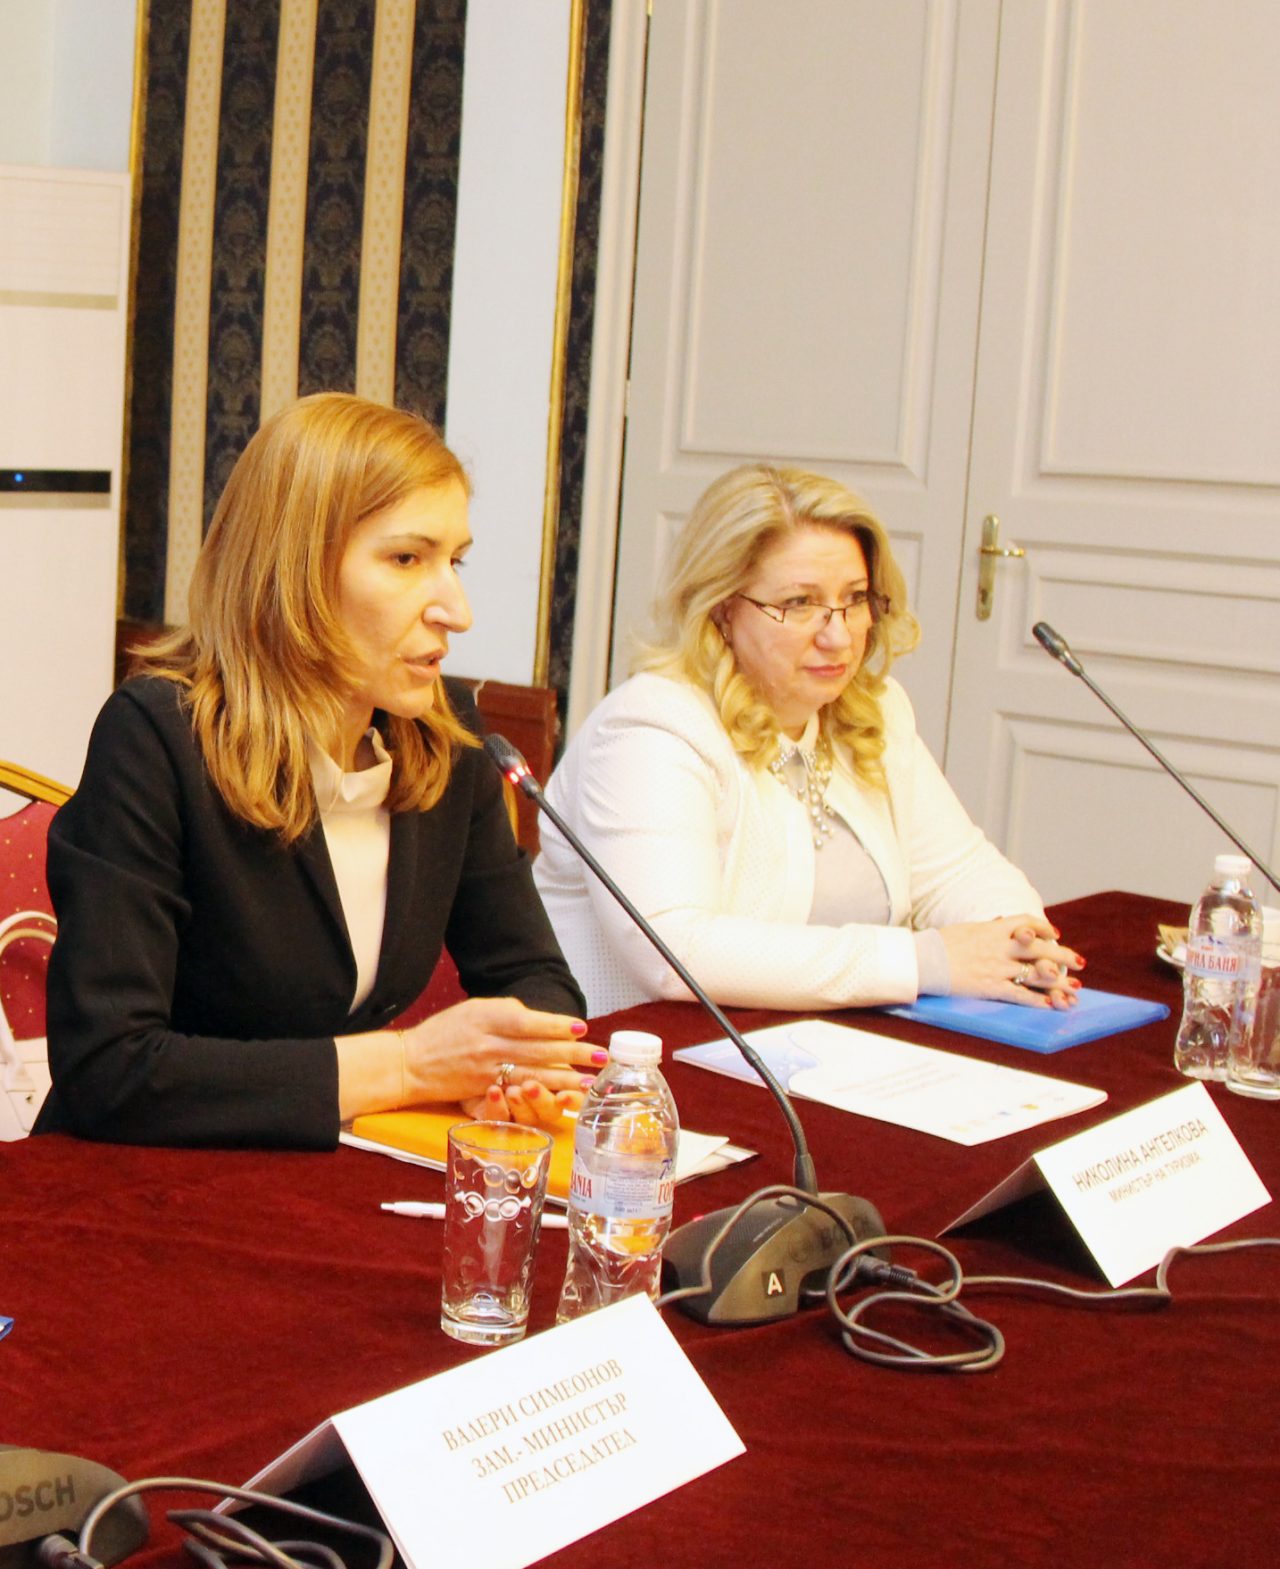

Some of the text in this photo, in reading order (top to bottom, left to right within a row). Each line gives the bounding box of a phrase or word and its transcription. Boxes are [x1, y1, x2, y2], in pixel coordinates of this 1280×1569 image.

[570, 1170, 593, 1199] ANIA
[1072, 1118, 1208, 1192] НИКОЛИНА АНГЕЛКОВА
[767, 1272, 783, 1295] A
[442, 1358, 623, 1451] ВАЛЕРИ СИМЕОНОВ
[522, 1392, 628, 1455] МИНИСТЪР
[501, 1427, 639, 1504] ПРЕДСЕДАТЕЛ
